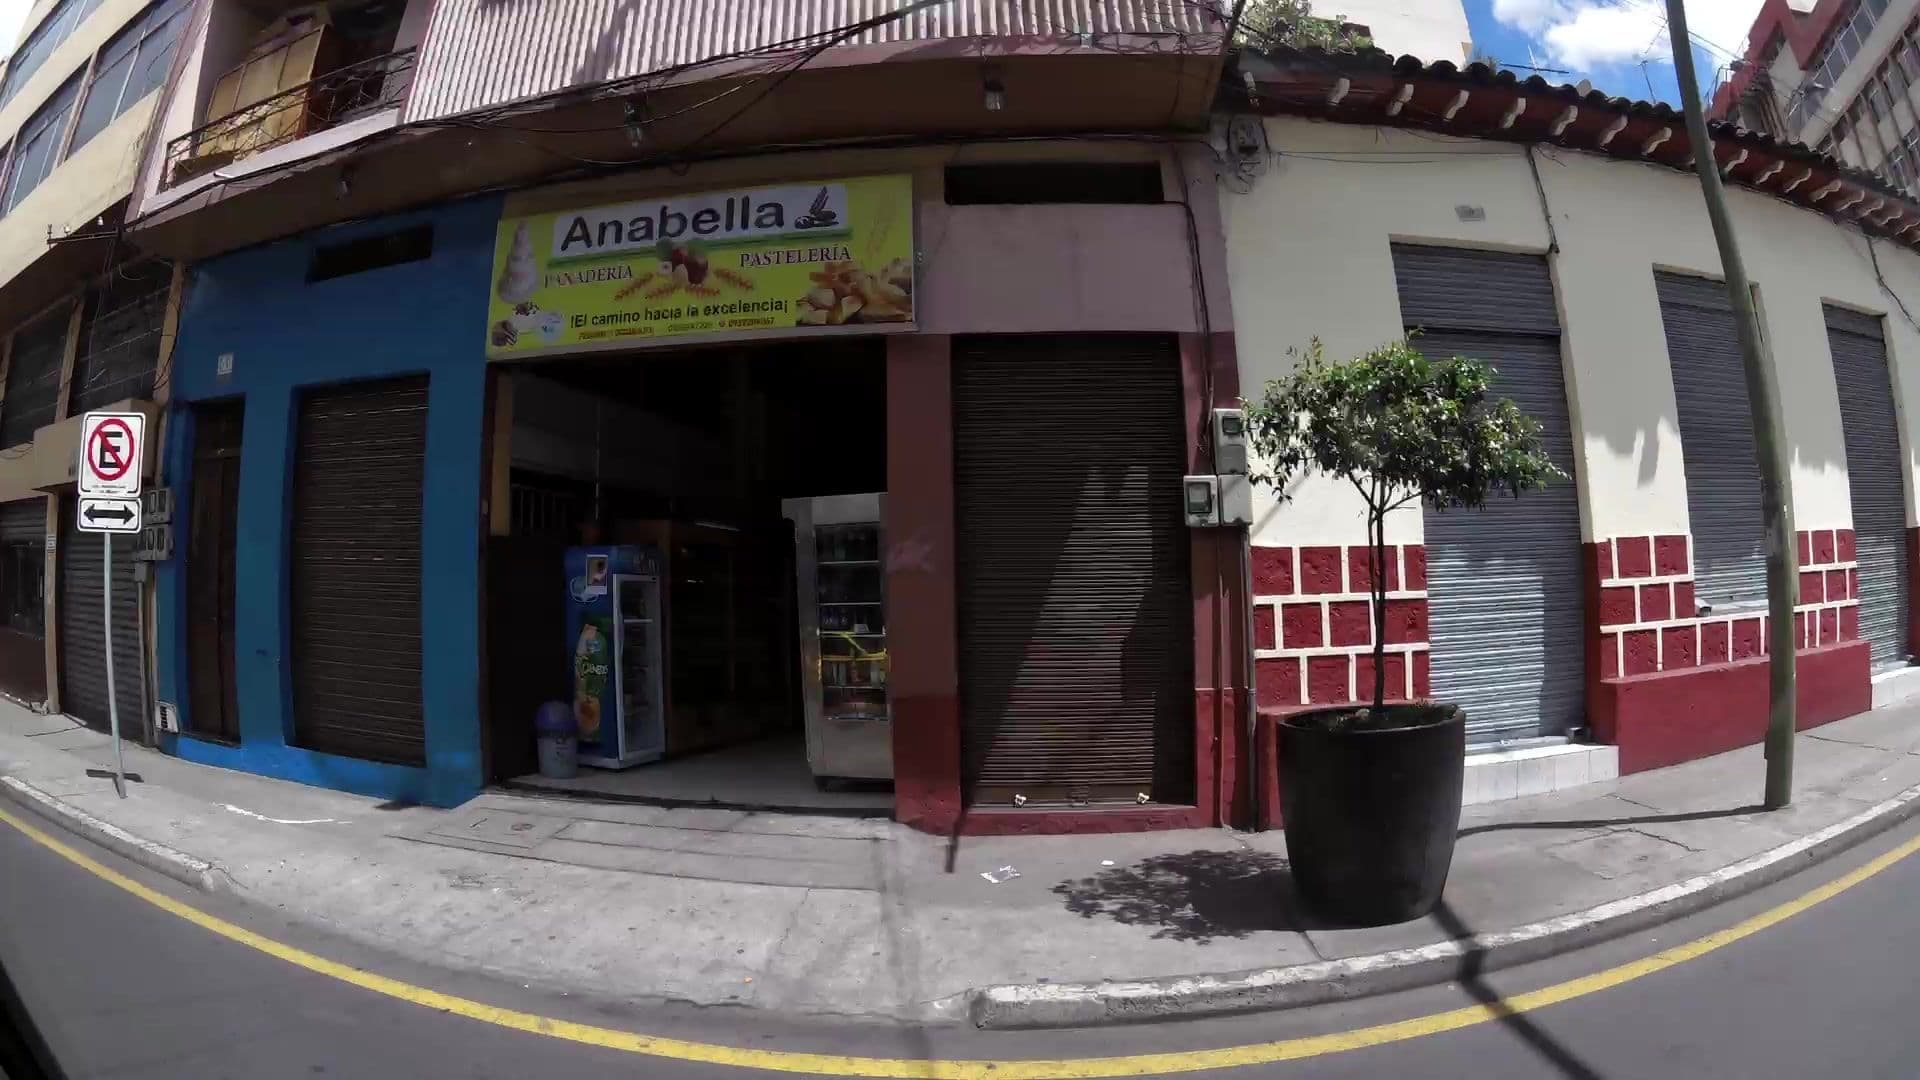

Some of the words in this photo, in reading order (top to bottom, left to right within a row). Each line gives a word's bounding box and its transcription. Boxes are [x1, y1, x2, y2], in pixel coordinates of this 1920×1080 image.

[560, 194, 784, 251] Anabella
[740, 245, 852, 268] PASTELERÍA
[591, 310, 640, 326] camino
[644, 307, 682, 320] hacia
[687, 305, 698, 317] la
[99, 431, 122, 468] E
